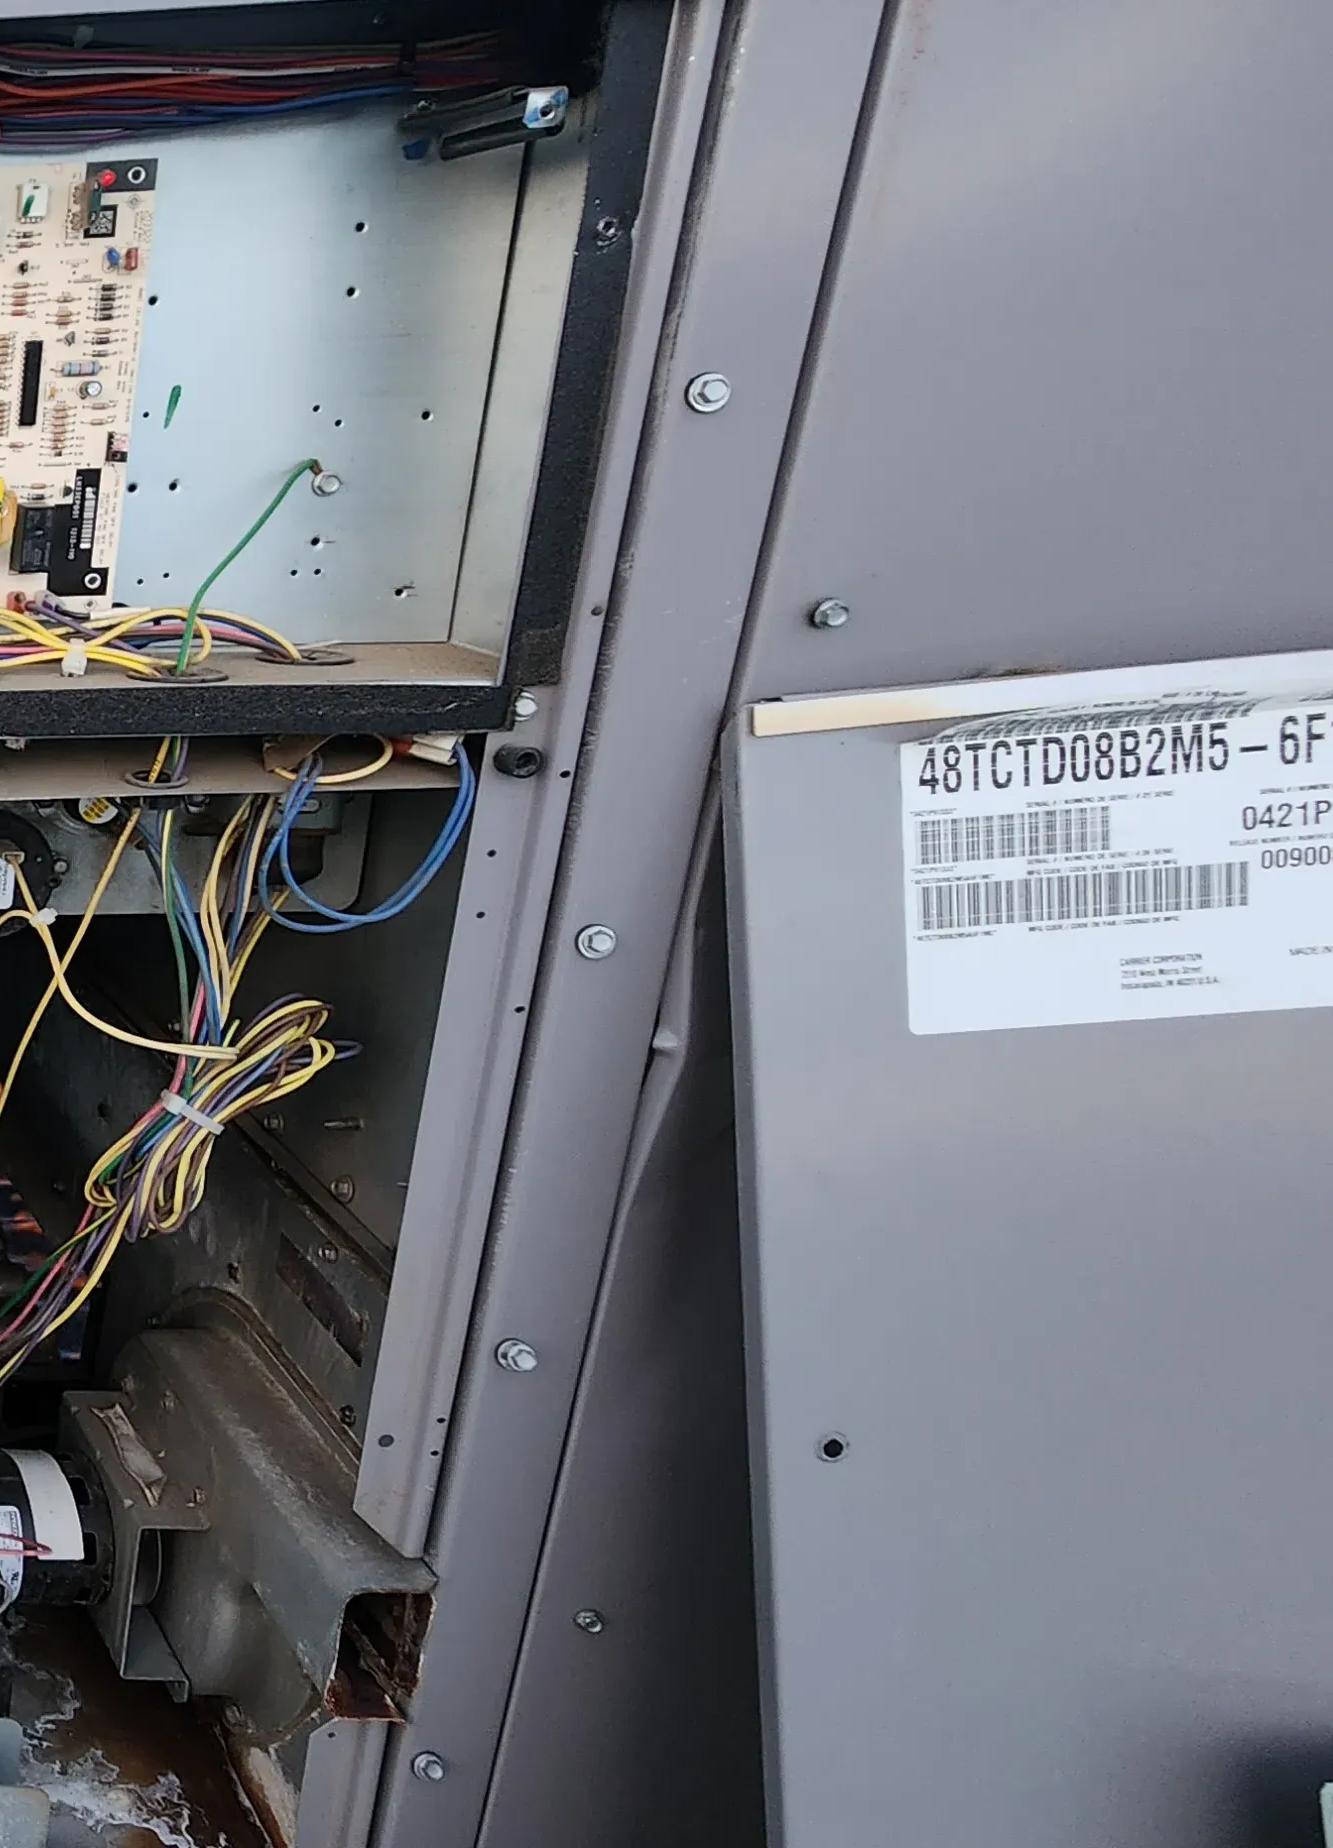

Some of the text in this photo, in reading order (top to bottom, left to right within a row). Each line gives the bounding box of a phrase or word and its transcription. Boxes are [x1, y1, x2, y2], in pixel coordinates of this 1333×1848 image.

[1279, 712, 1333, 765] 6F
[1242, 800, 1331, 830] 0421P
[1261, 845, 1331, 869] 00900
